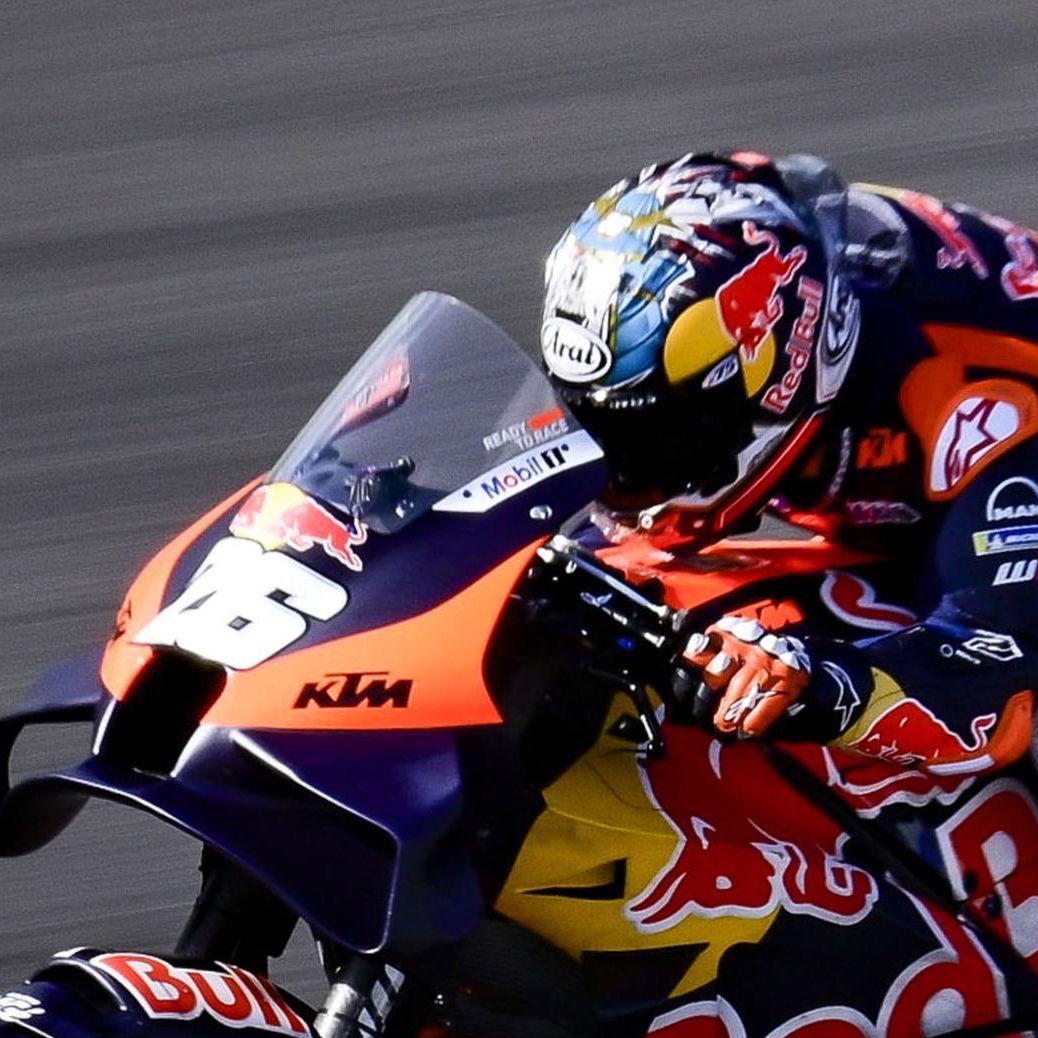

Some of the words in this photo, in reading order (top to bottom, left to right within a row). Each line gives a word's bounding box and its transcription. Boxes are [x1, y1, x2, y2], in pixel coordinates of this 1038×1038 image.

[760, 336, 813, 415] Red
[788, 275, 824, 347] Bull
[483, 421, 528, 452] READY
[515, 432, 534, 450] TO
[533, 418, 569, 444] RACE
[481, 456, 544, 499] Mobil
[540, 446, 566, 469] 1
[293, 671, 414, 709] KTM
